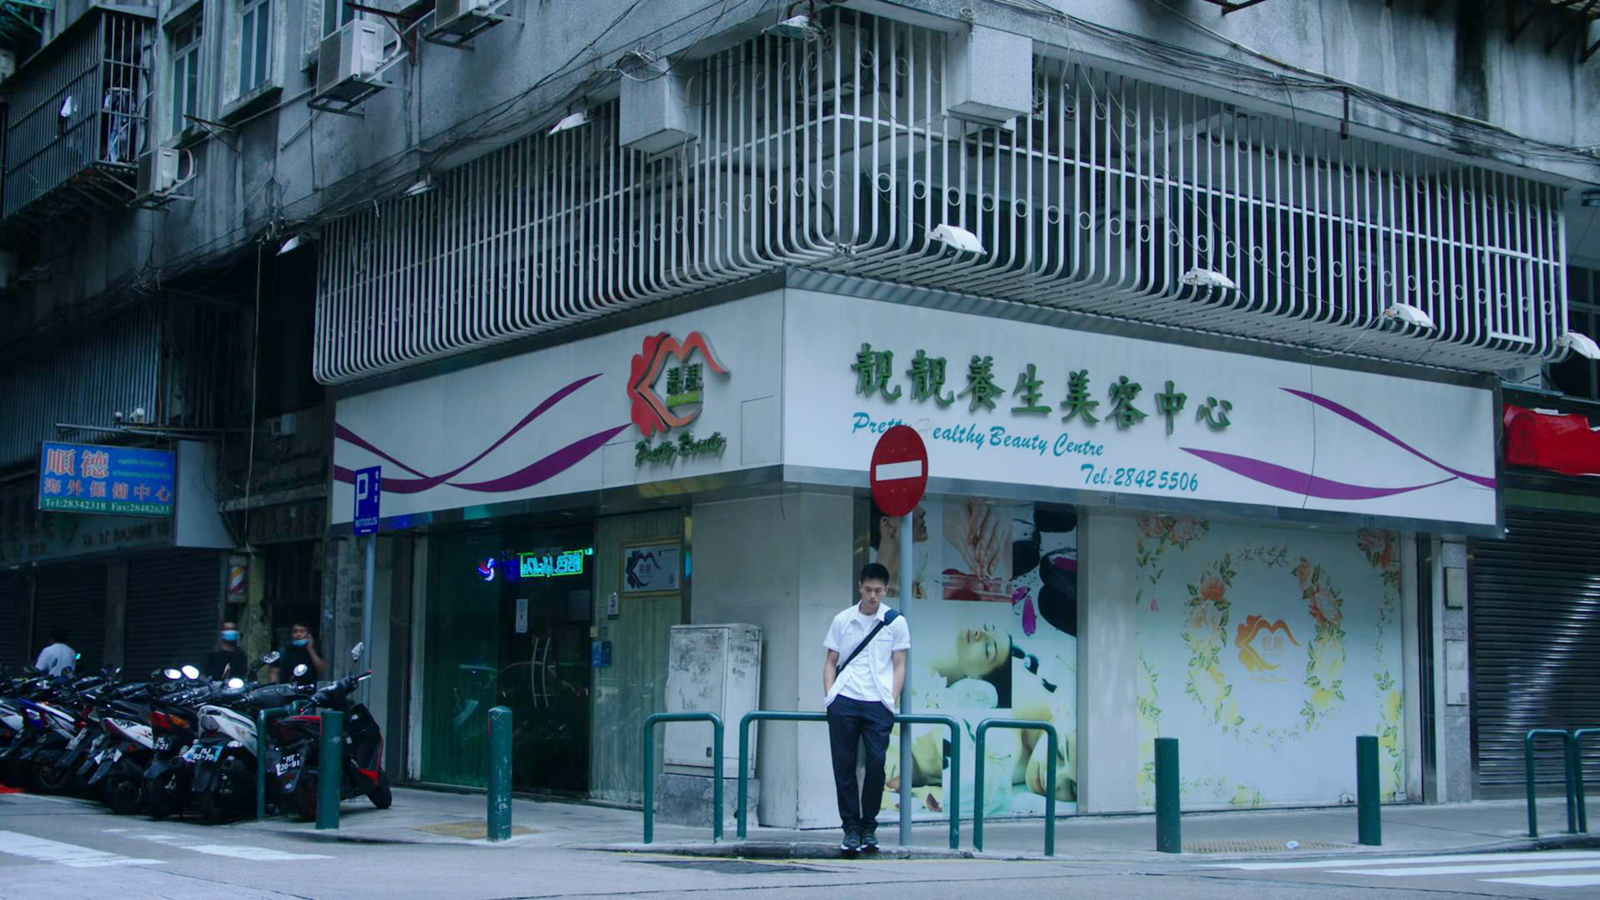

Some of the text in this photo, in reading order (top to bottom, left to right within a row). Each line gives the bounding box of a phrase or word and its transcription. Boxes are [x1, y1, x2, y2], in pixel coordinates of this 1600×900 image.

[851, 343, 1232, 436] 靚靚養生美容中心
[852, 412, 911, 434] Prett
[989, 426, 1048, 455] Beauty
[1053, 432, 1104, 457] Centre
[45, 448, 110, 479] 順德
[1080, 463, 1198, 492] Tel:28425506
[355, 472, 369, 517] P
